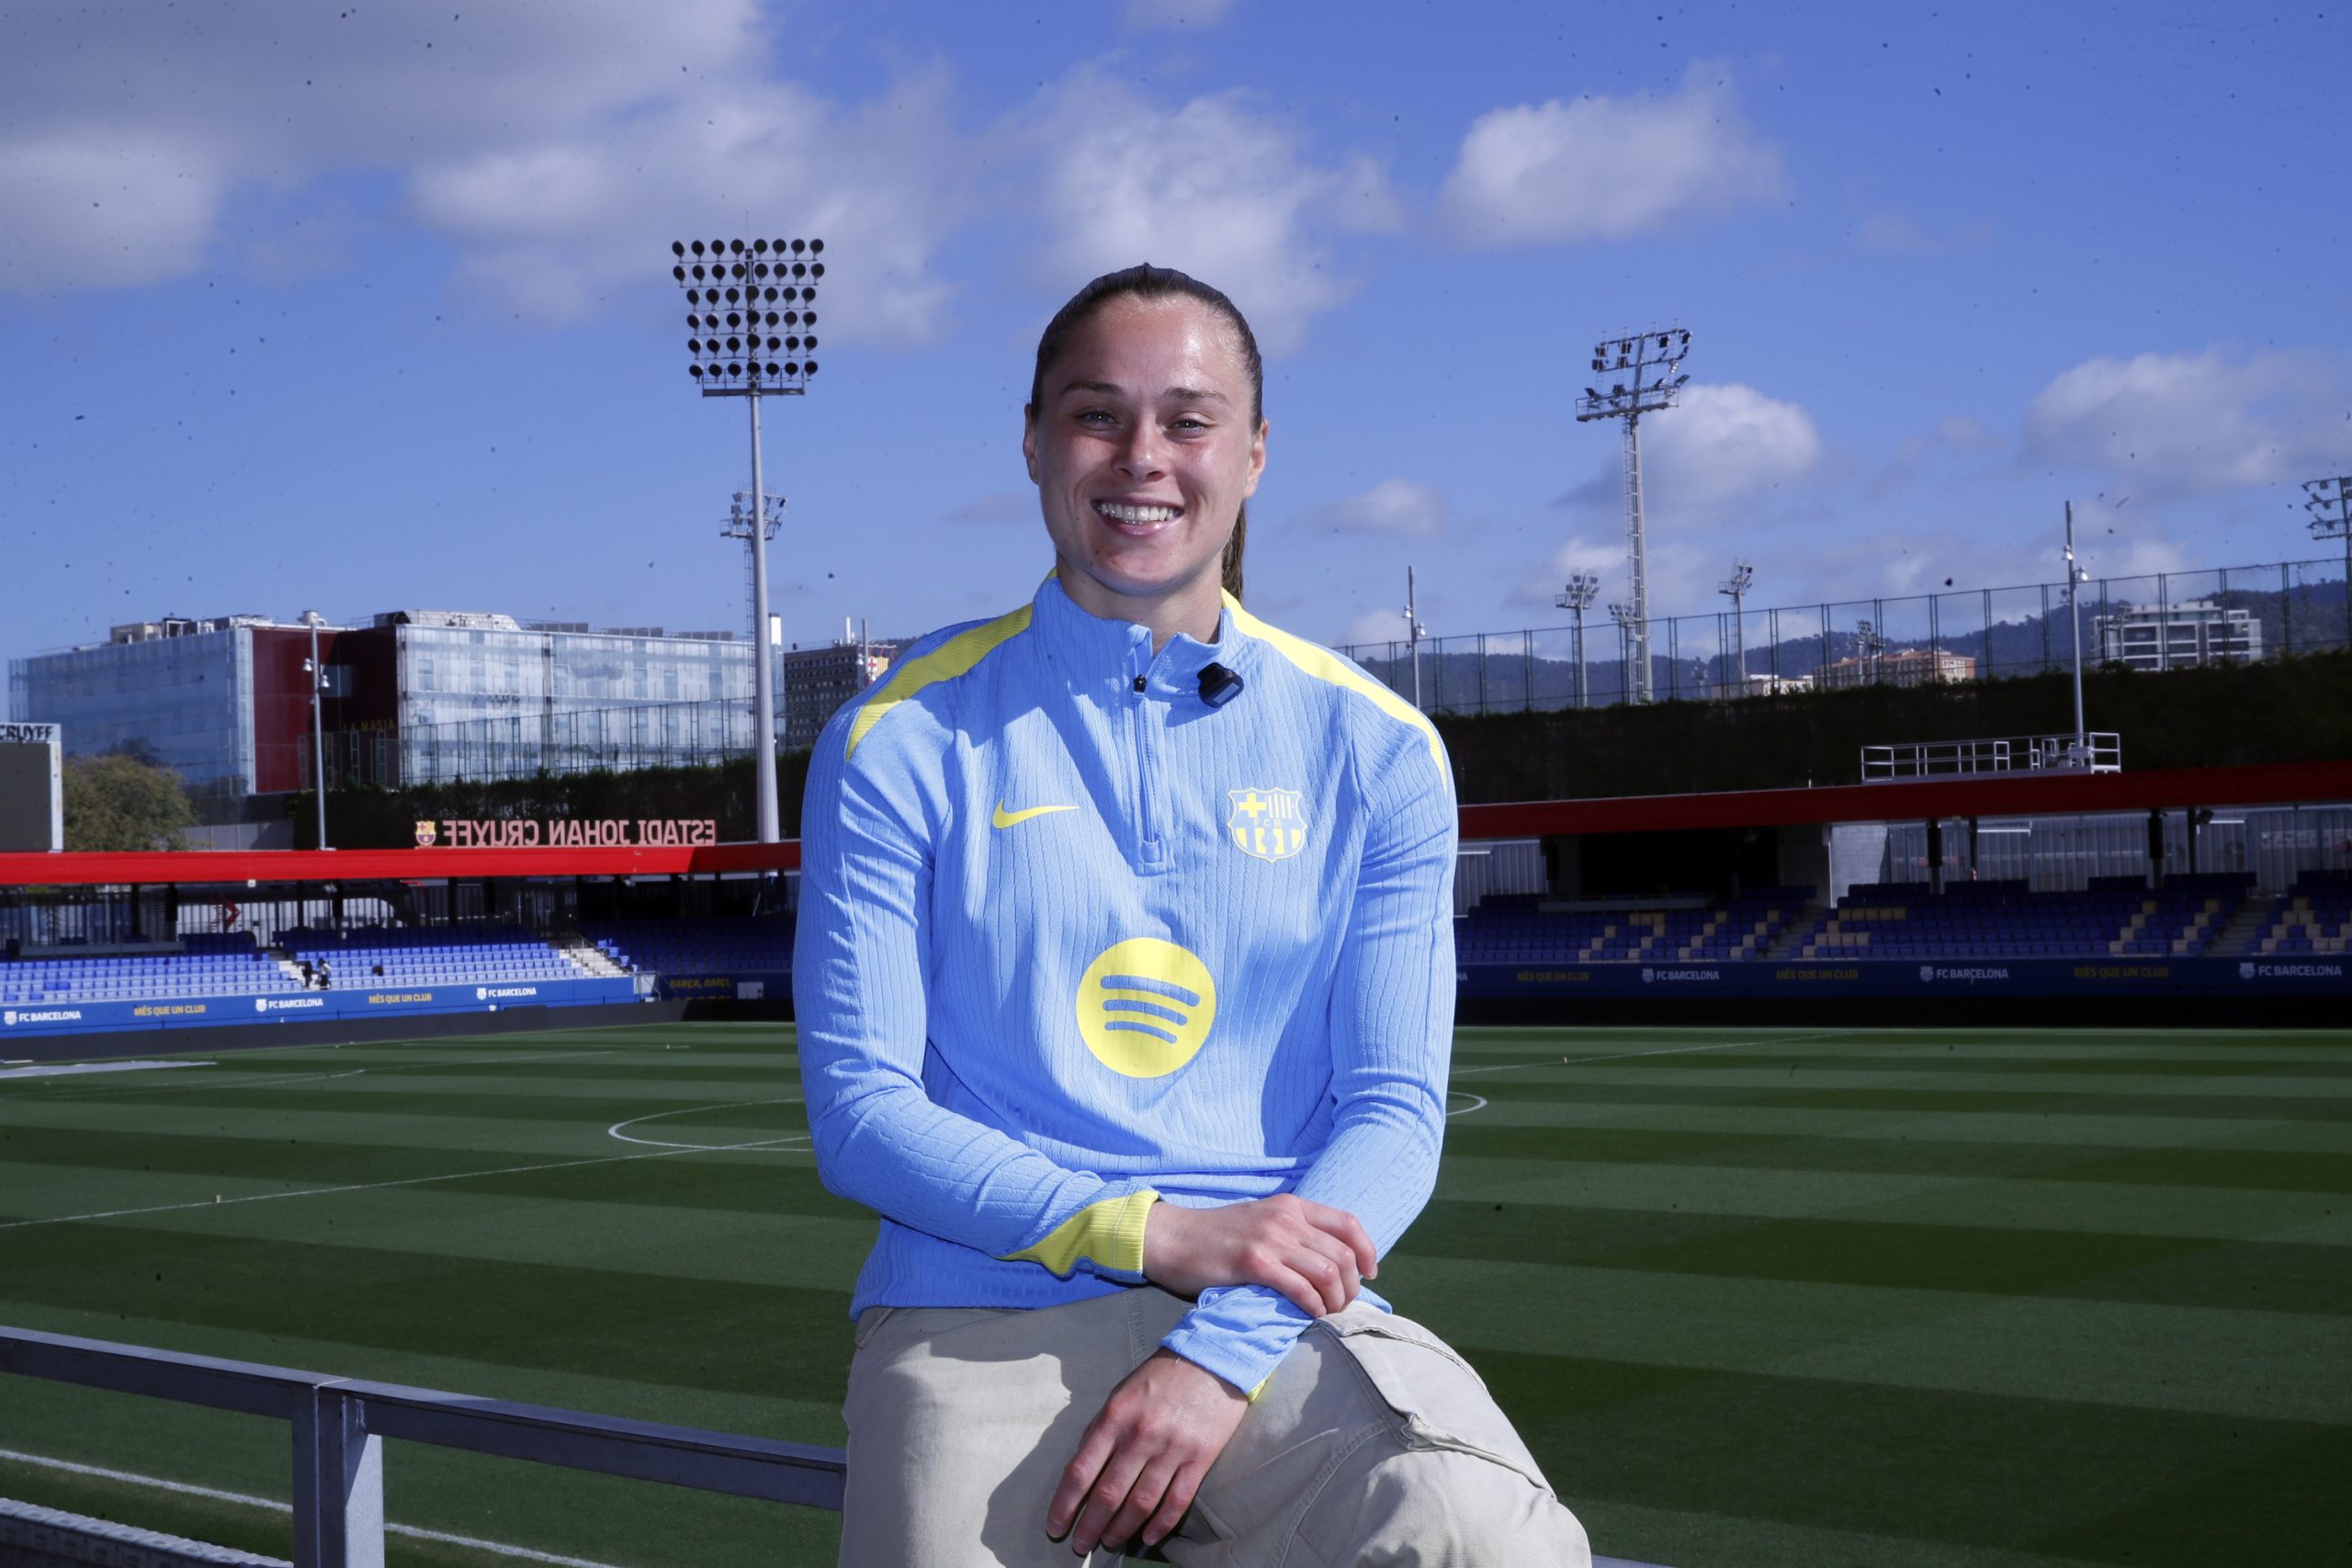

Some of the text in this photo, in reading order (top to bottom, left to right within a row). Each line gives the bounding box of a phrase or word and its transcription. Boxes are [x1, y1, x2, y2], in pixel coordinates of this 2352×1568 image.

[1253, 818, 1282, 828] FCB
[1657, 970, 1720, 980] FC BARCELONA
[1798, 969, 1817, 981] QUE
[1818, 969, 1833, 980] UN
[1834, 969, 1859, 980] CLUB
[1937, 968, 2009, 979] FC BARCELONA
[2099, 966, 2121, 979] QUE
[2123, 966, 2139, 978] UN
[2141, 966, 2169, 978] CLUB
[2258, 965, 2343, 976] FC BARCELONA
[488, 987, 537, 998] FC BARCELONA
[268, 998, 323, 1009] FC BARCELONA
[368, 993, 433, 1004] MÉS QUE UN CLUB
[19, 1011, 81, 1021] FC BARCELONA
[153, 1006, 171, 1017] QUE
[172, 1006, 184, 1014] UN
[185, 1004, 207, 1014] CLUB
